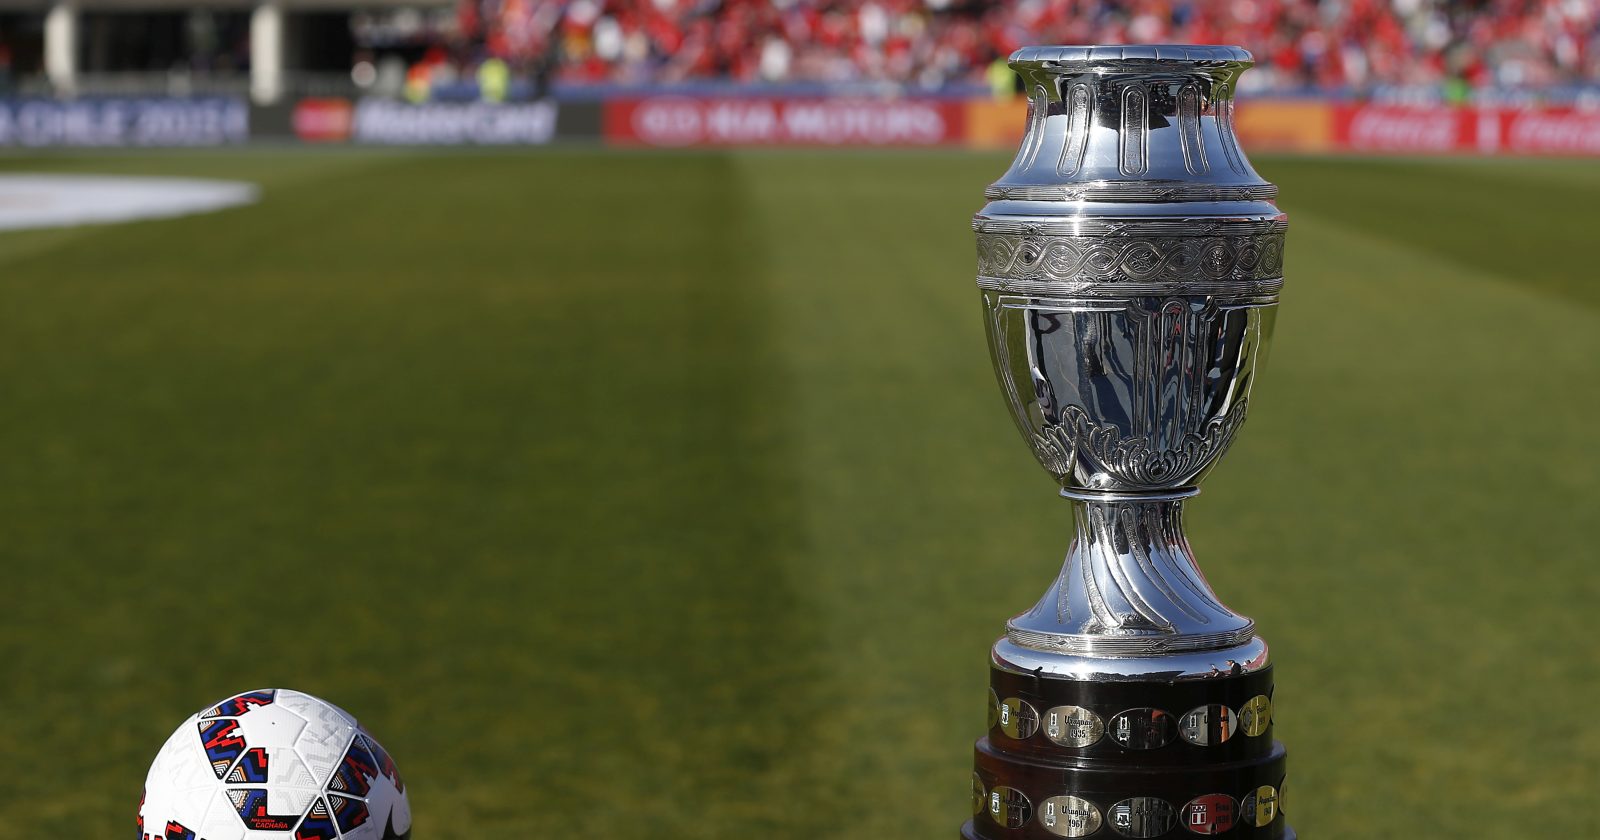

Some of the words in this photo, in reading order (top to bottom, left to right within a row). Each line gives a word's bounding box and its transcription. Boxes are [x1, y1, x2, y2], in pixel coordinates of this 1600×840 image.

[1064, 715, 1094, 729] Uruguay
[1062, 806, 1092, 818] Uruguay
[1068, 819, 1083, 829] 1961
